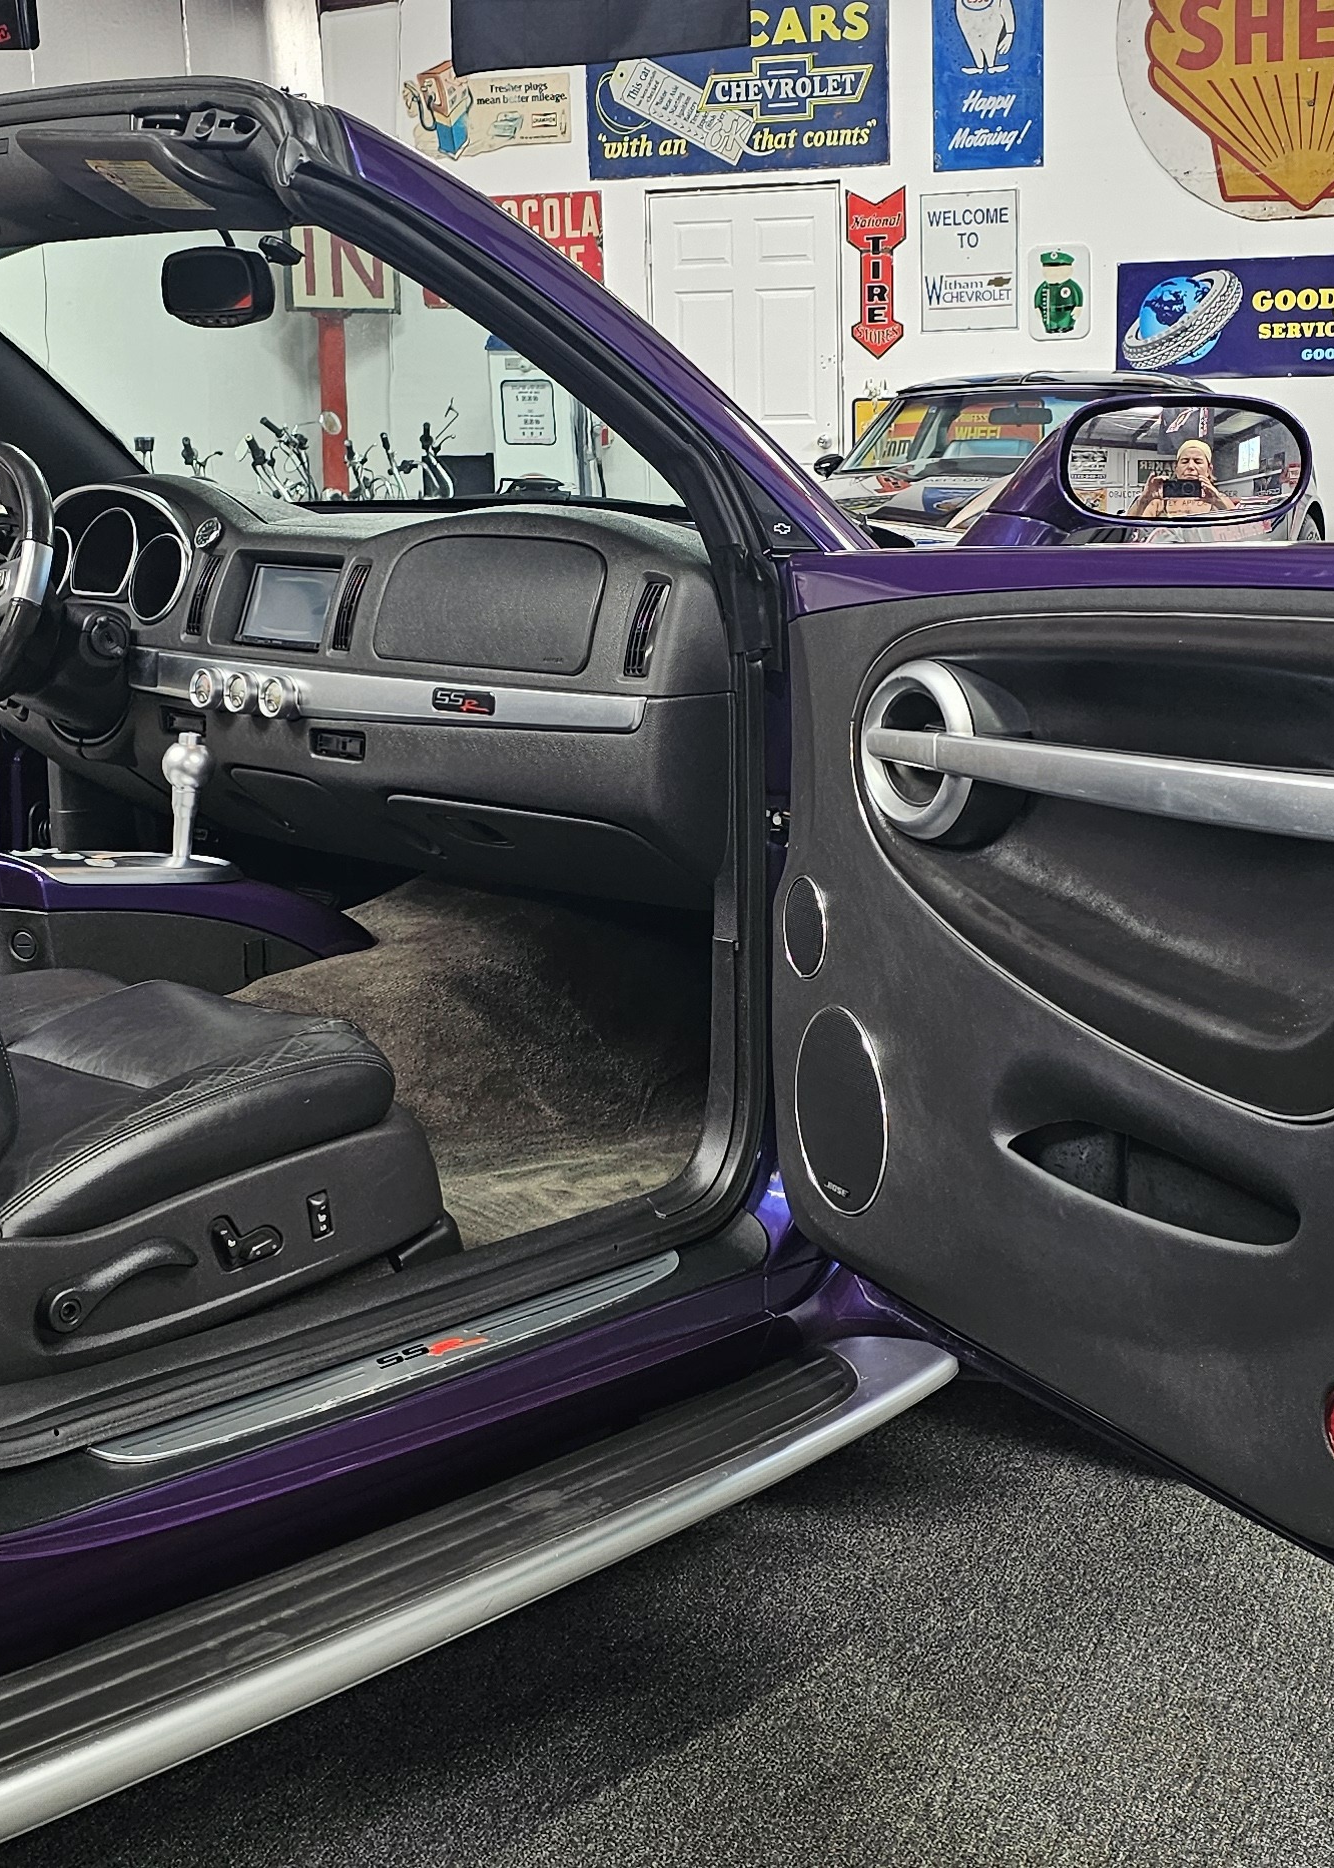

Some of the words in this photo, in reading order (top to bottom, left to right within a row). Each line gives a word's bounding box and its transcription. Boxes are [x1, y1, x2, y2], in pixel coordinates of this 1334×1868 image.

[750, 2, 870, 48] CARS
[524, 82, 548, 93] plugs
[627, 82, 643, 100] This
[640, 66, 651, 83] car
[715, 74, 856, 102] CHEVROLET
[476, 96, 501, 105] mean
[532, 92, 568, 103] mileage.
[962, 89, 1016, 119] Happy
[659, 138, 687, 156] an
[752, 128, 798, 150] that
[948, 120, 1032, 152] Motoring!
[851, 212, 902, 230] National
[928, 206, 1009, 227] WELCOME
[957, 232, 978, 248] TO
[303, 227, 384, 298] IN
[865, 234, 888, 324] TIRE
[942, 288, 1012, 304] CHEVROLET
[856, 324, 900, 346] STORES
[823, 1180, 850, 1198] BOSE
